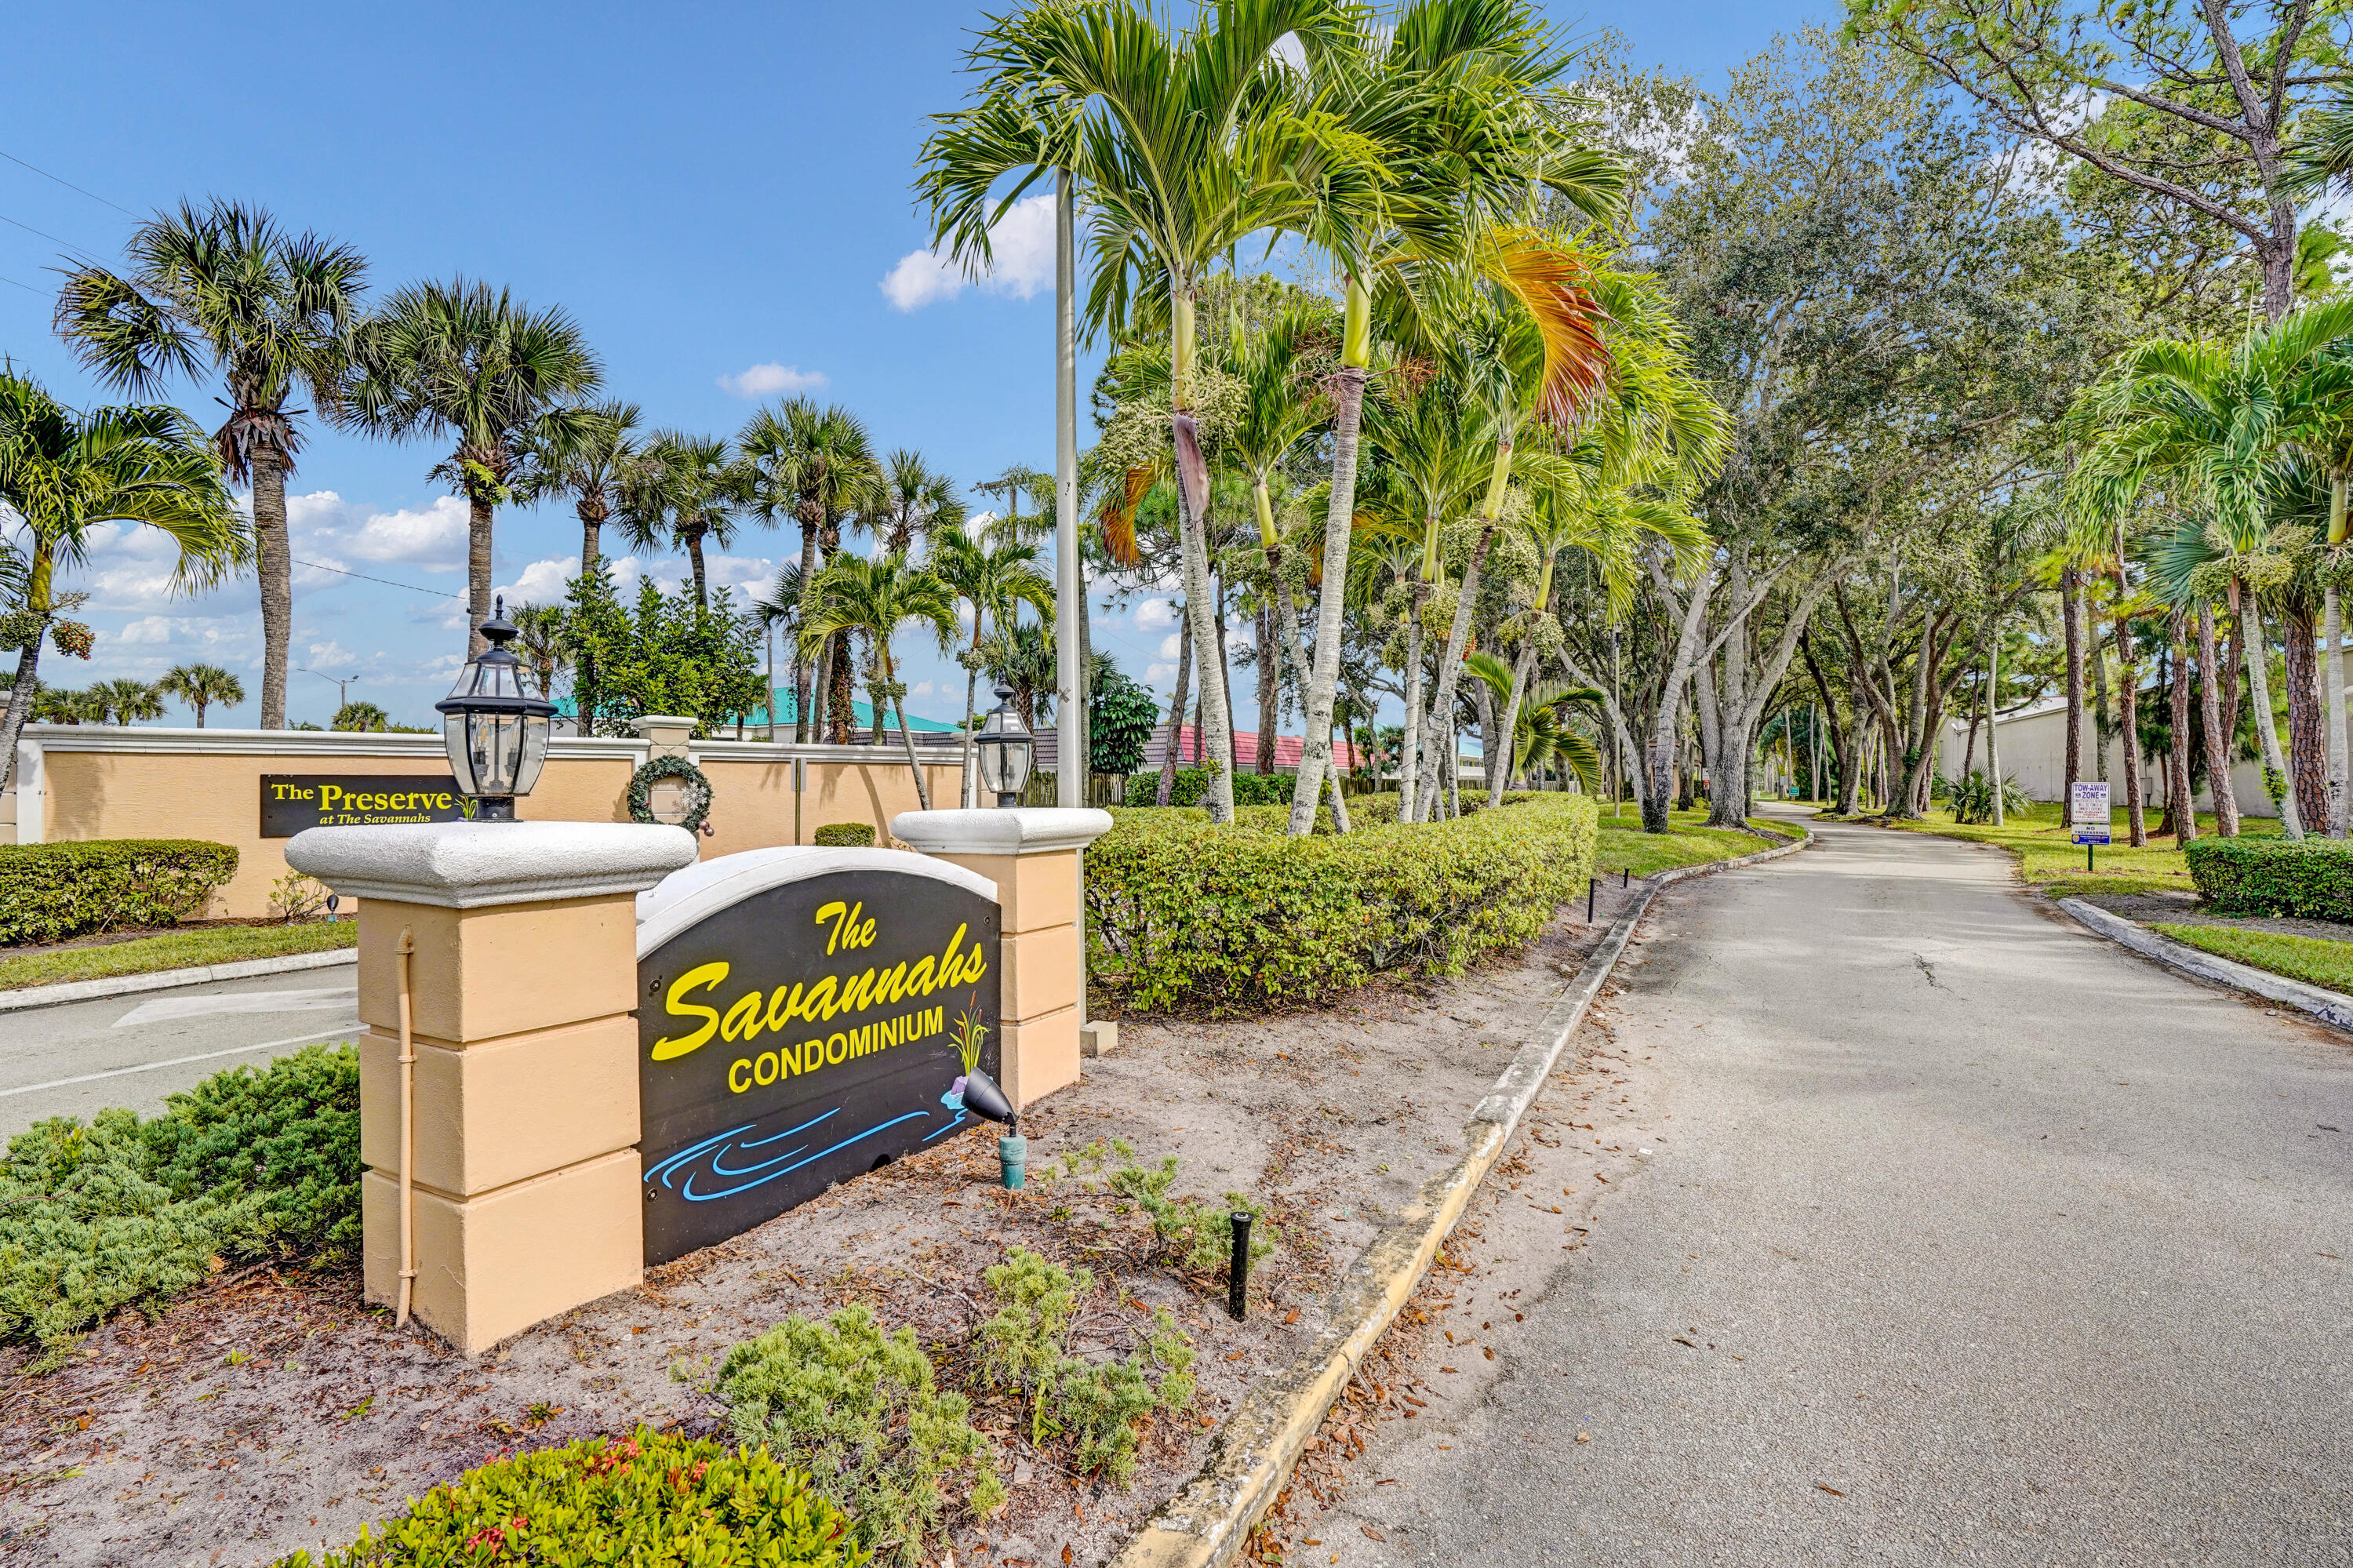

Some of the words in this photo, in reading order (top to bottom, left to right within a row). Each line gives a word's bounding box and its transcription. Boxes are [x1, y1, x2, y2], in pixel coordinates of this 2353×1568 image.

[271, 784, 314, 800] The
[318, 785, 453, 811] Preserve
[319, 815, 333, 824] at
[337, 814, 361, 824] The
[363, 813, 431, 824] Savannahs
[815, 900, 877, 956] The
[650, 922, 987, 1061] Savannahs
[729, 1006, 944, 1093] CONDOMINIUM
